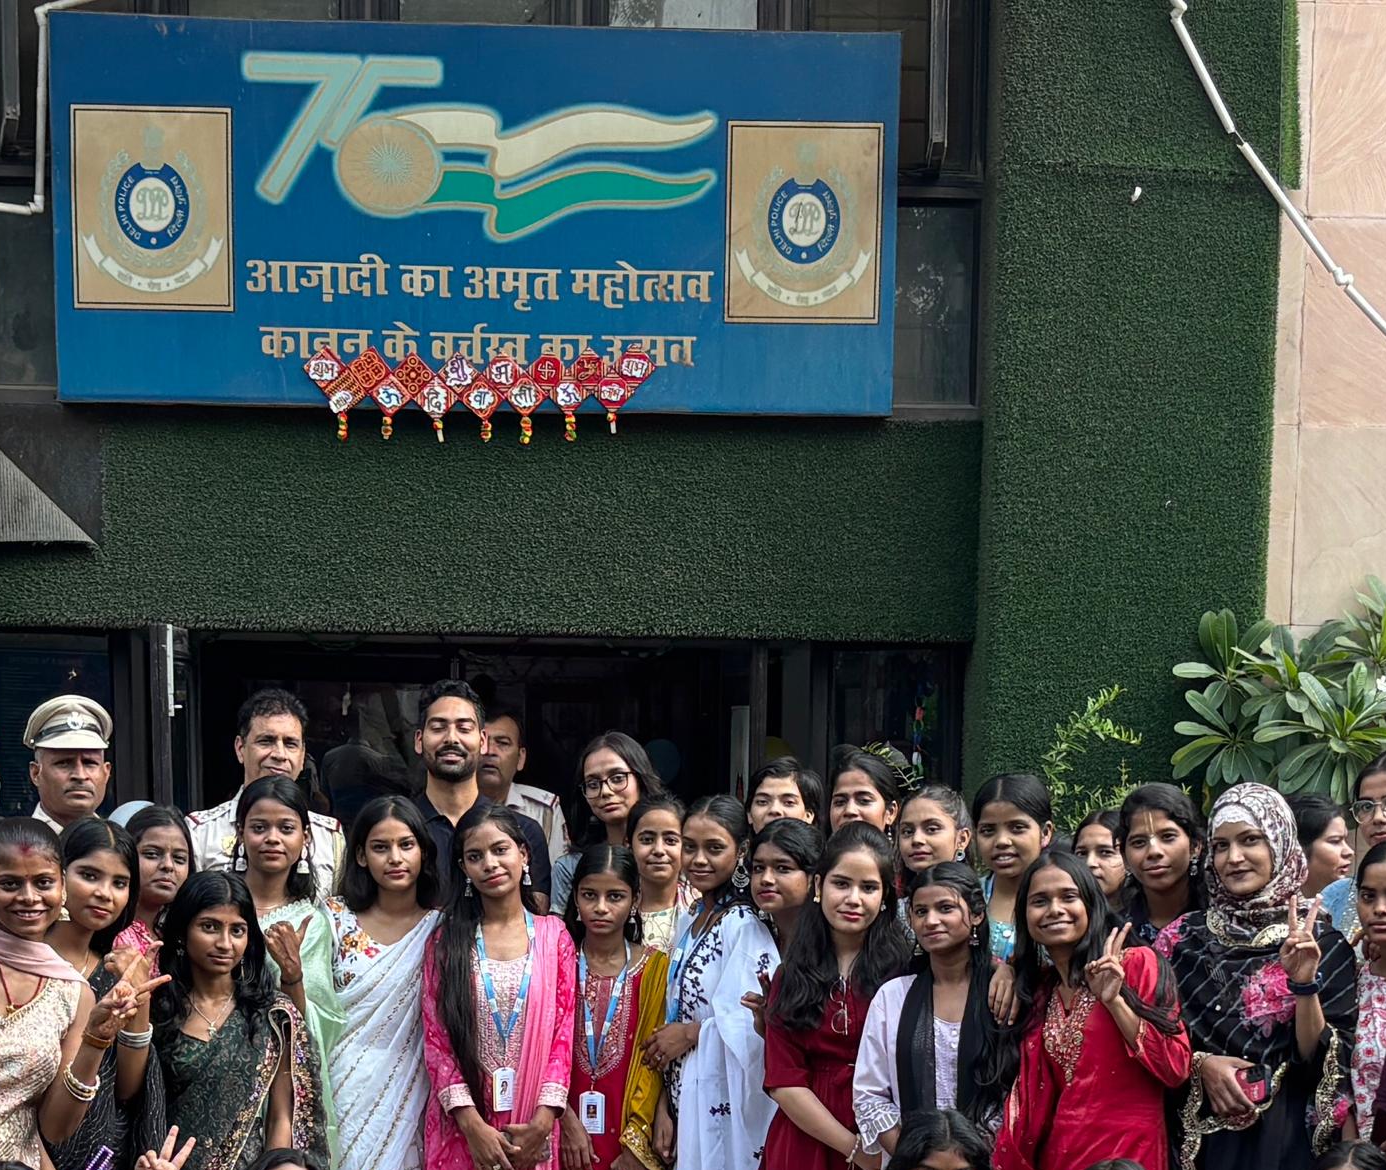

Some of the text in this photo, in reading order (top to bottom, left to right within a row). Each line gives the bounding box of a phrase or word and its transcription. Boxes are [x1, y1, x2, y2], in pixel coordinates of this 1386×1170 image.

[117, 175, 142, 241] DELHI POLICE
[770, 191, 793, 255] DELHI POLICE
[246, 253, 714, 311] आज़ादी का अमृत महोत्सव
[382, 321, 420, 362] के
[539, 335, 593, 365] का
